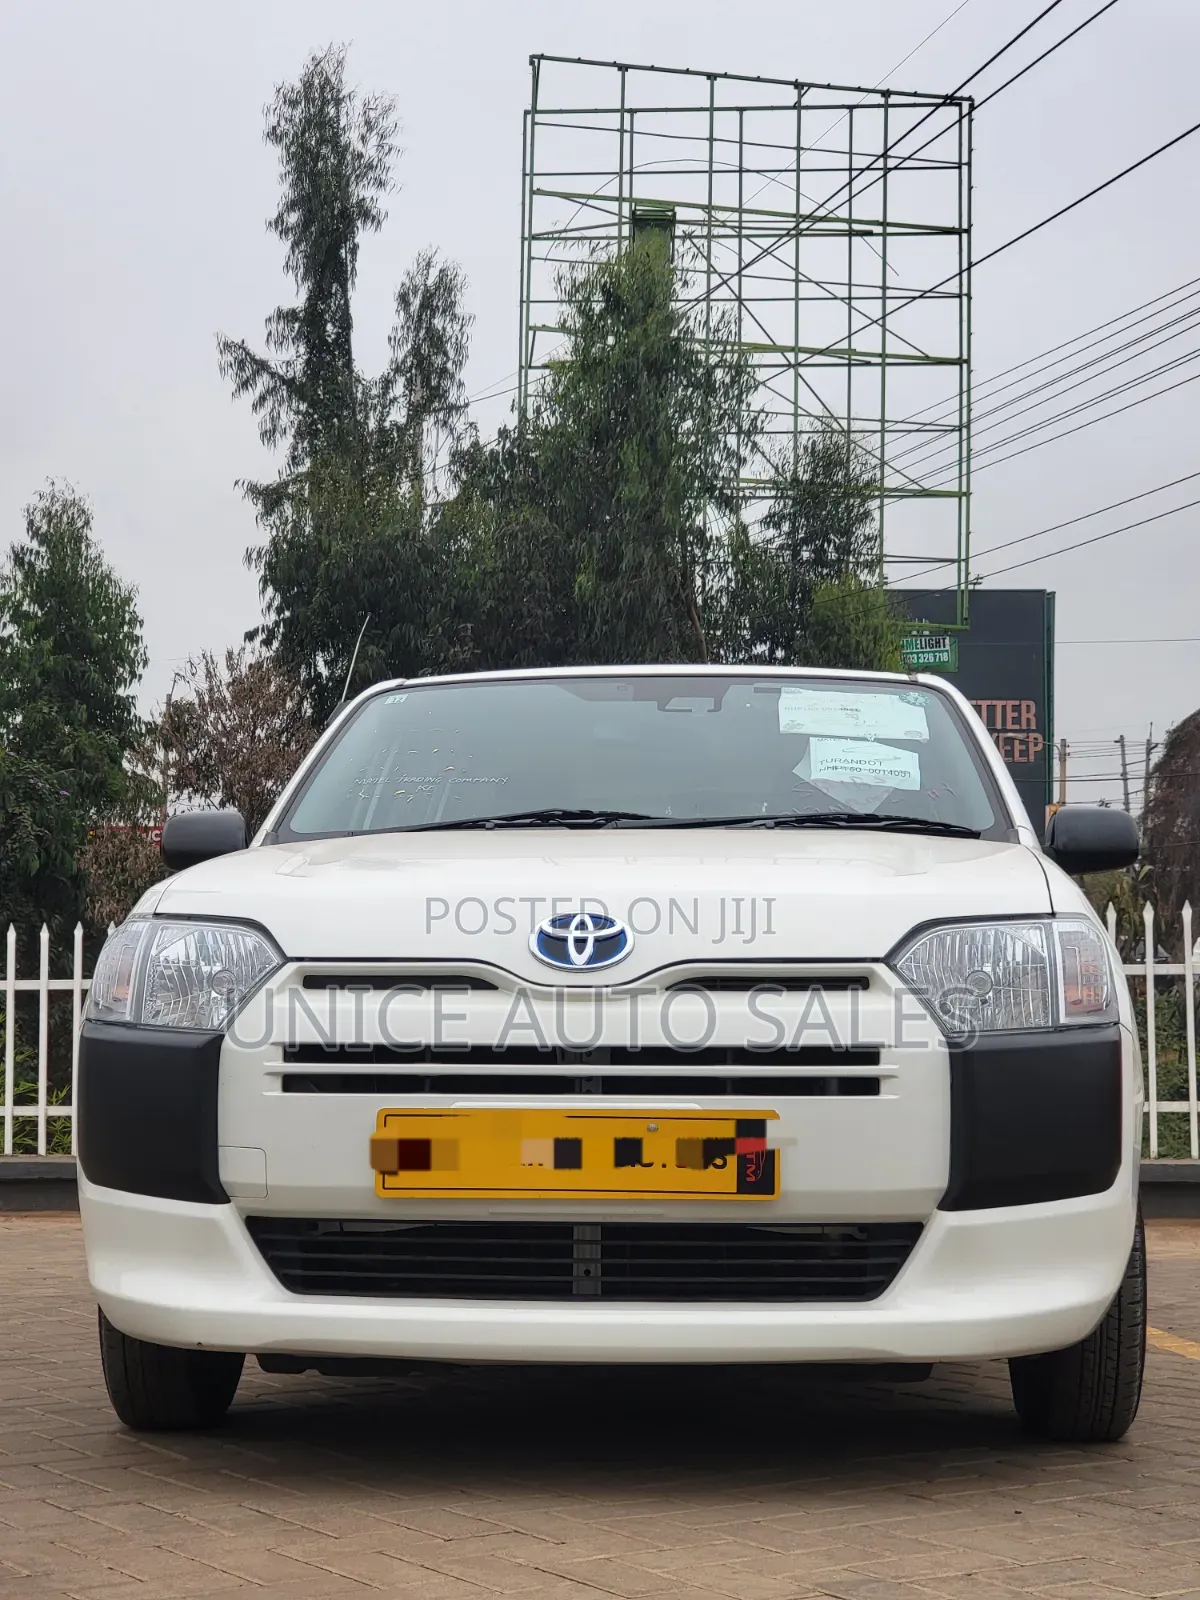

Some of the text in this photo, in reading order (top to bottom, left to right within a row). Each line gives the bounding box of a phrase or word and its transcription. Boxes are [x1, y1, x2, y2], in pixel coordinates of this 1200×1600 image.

[918, 653, 934, 663] 326
[935, 651, 949, 662] 718
[970, 699, 1038, 730] TTER
[992, 733, 1046, 763] EEP
[448, 776, 508, 784] COMPANY
